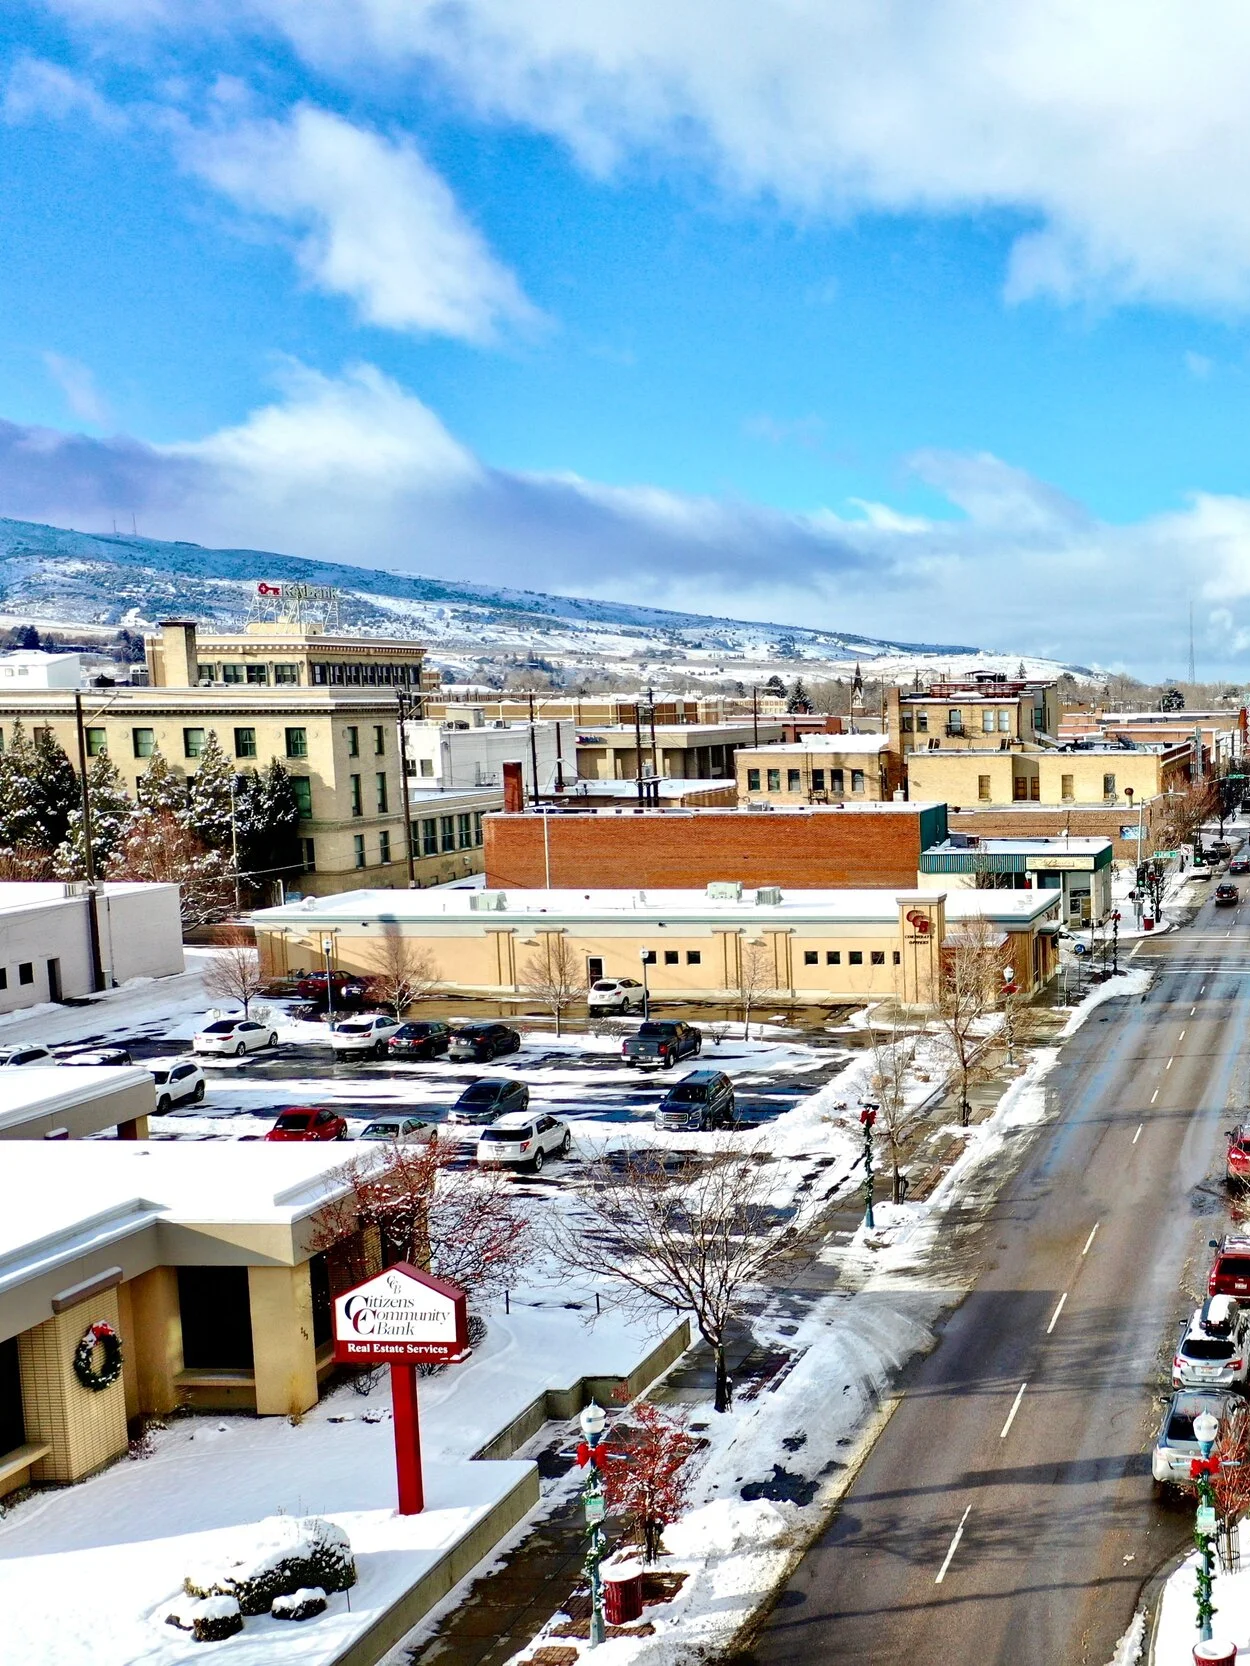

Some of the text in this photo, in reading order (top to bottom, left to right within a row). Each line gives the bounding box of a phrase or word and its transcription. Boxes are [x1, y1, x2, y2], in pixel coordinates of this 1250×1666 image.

[344, 1295, 415, 1321] Citizens
[352, 1308, 451, 1335] Community
[376, 1321, 416, 1336] Bank
[347, 1343, 449, 1354] Real Estate Services
